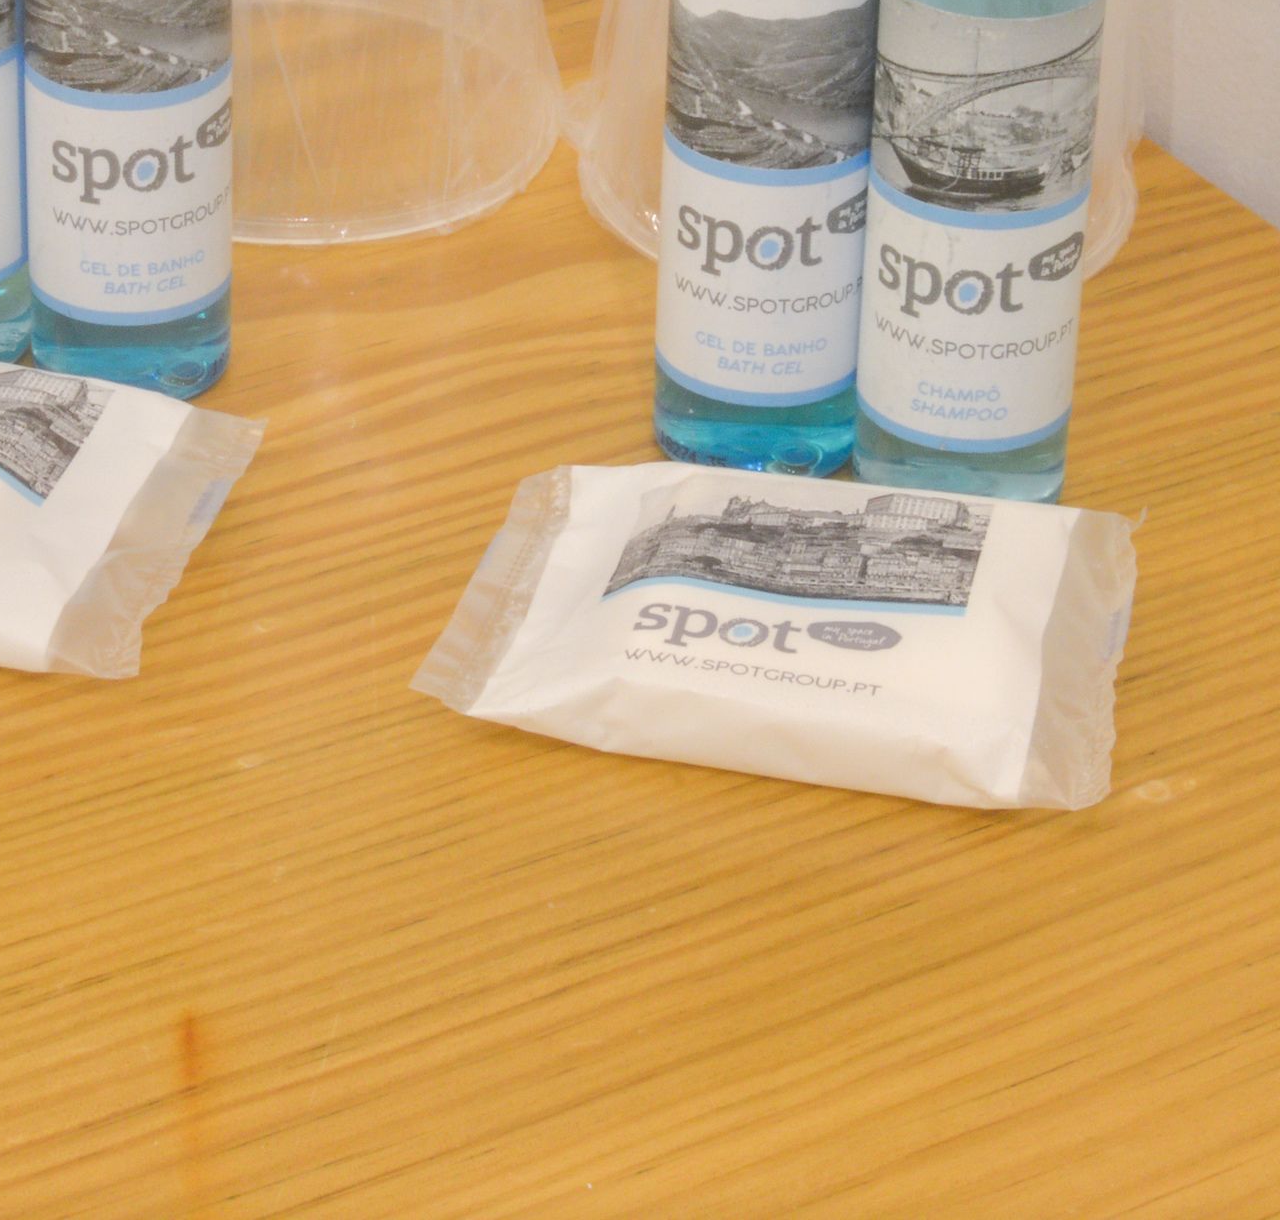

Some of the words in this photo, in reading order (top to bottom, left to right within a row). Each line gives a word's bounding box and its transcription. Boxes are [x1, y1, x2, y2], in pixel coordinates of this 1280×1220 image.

[51, 135, 195, 205] spot
[677, 204, 823, 275] spot
[80, 260, 112, 276] GEL
[118, 263, 141, 277] DE
[147, 250, 205, 276] BANHO
[878, 243, 1023, 319] spot
[104, 281, 151, 295] BATH
[156, 276, 186, 292] GEL
[696, 331, 726, 350] GEL
[733, 340, 757, 356] DE
[764, 338, 828, 357] BANHO
[875, 317, 1074, 360] WWW.SPOTGROUP.PT
[718, 356, 766, 373] BATH
[772, 361, 804, 375] GEL
[910, 398, 1008, 420] SHAMPOO
[632, 602, 802, 654] spot
[624, 647, 883, 697] WWW.SPOTGROUP.PT
